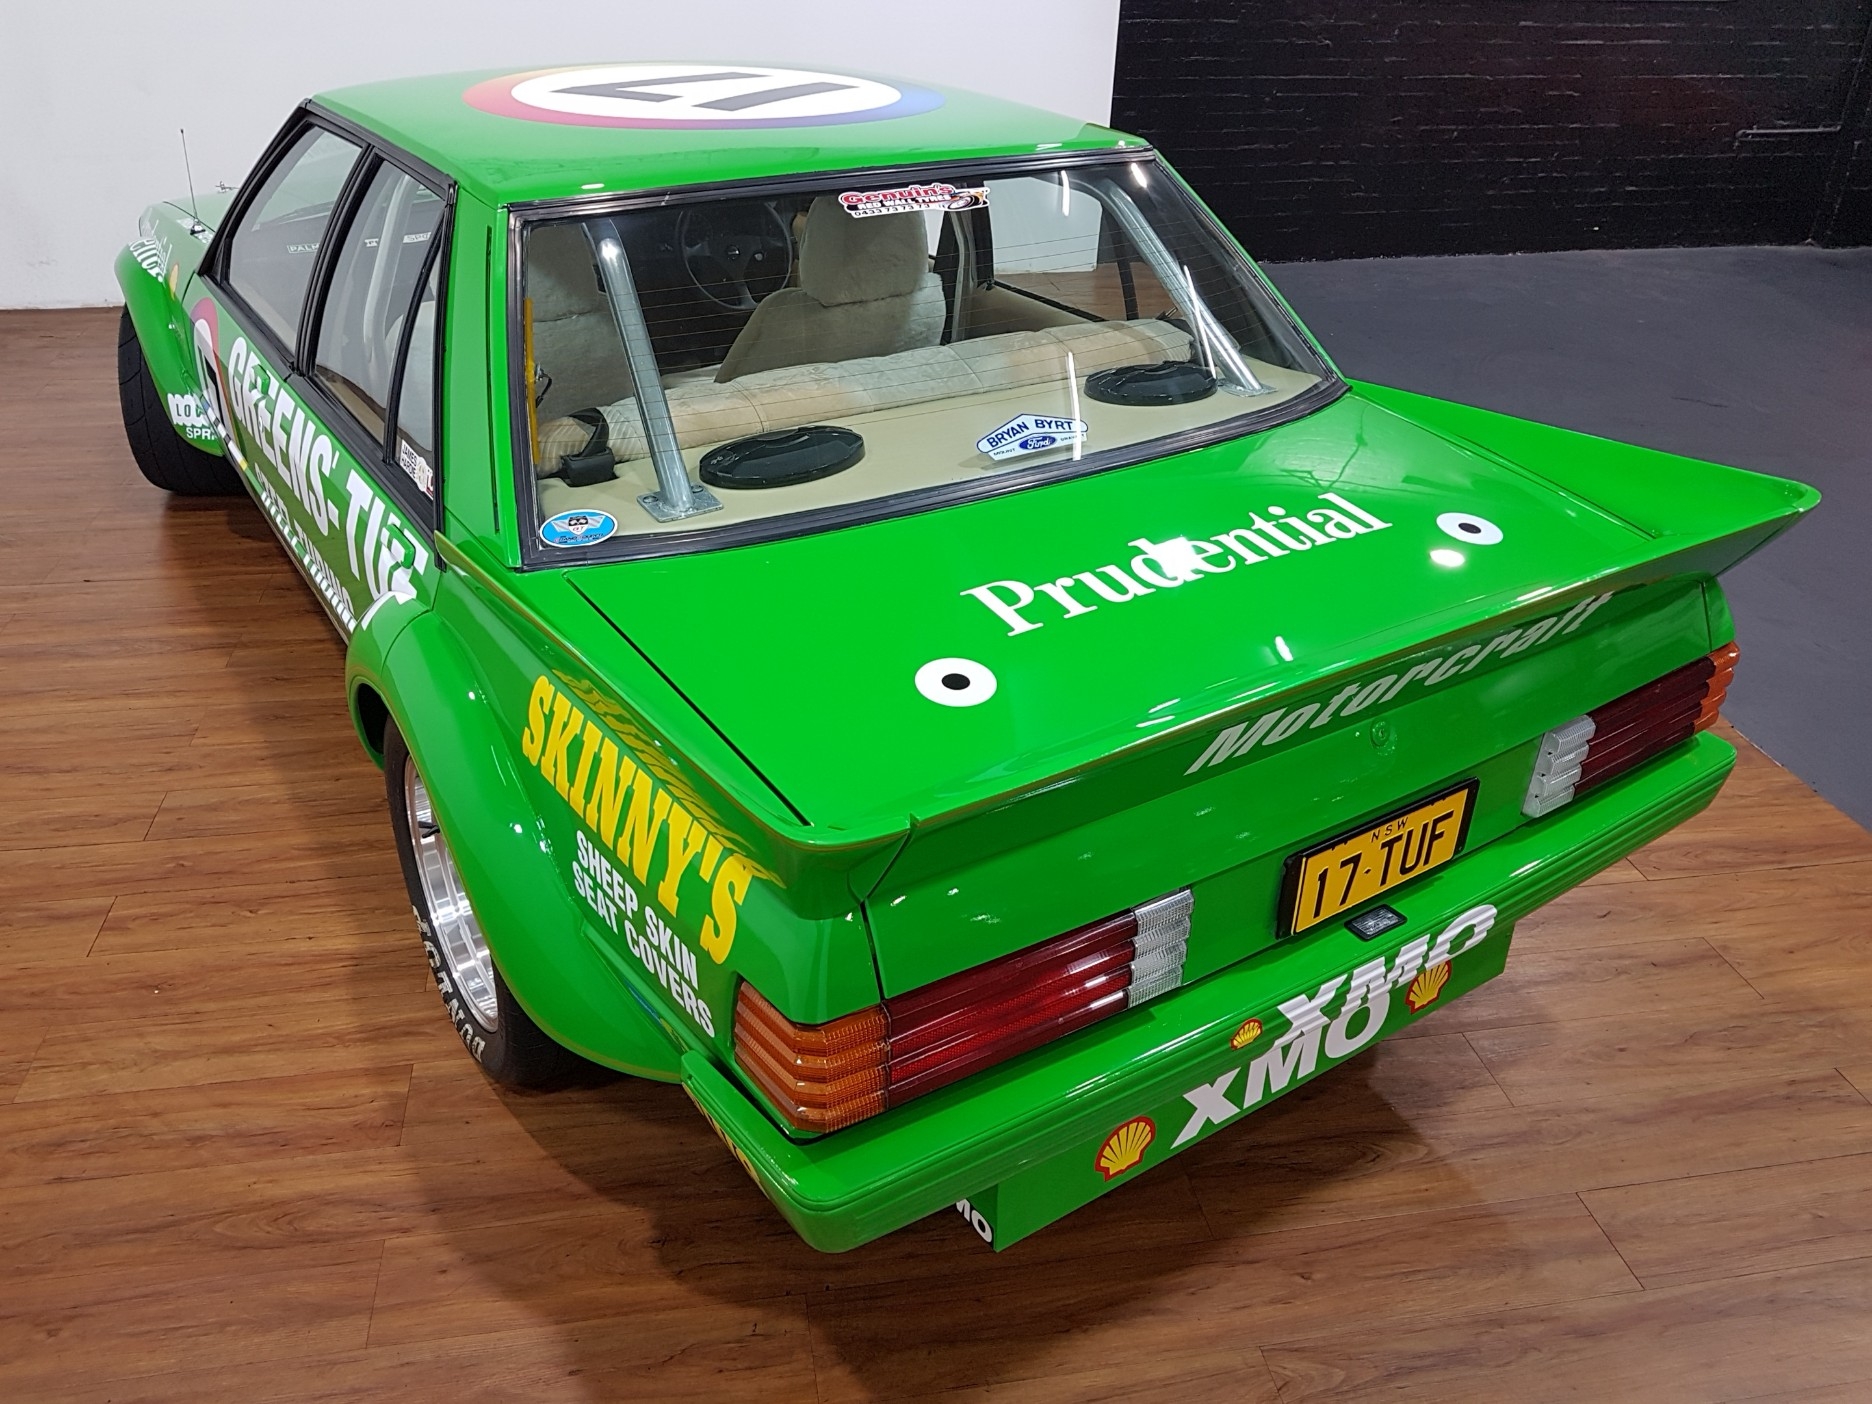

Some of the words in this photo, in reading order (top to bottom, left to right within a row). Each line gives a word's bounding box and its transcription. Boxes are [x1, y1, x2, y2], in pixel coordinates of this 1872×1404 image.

[854, 207, 883, 218] 0433
[886, 205, 899, 214] 73
[902, 203, 915, 213] 73
[917, 202, 931, 212] 73
[857, 201, 882, 211] RED
[884, 198, 915, 209] WALL
[915, 193, 952, 205] TYRES
[986, 421, 1030, 448] BRYAN
[1034, 418, 1073, 431] BYRT
[959, 492, 1393, 637] Prudential
[1183, 591, 1616, 776] Motorcraft
[522, 675, 752, 964] SKINNY'S
[1371, 816, 1409, 843] NSW
[572, 861, 619, 935] SEAT
[624, 919, 715, 1038] COVERS
[576, 830, 638, 918] SHEEP
[644, 906, 699, 990] SKIN
[1267, 904, 1498, 1053] XMO
[1170, 986, 1390, 1150] XMO
